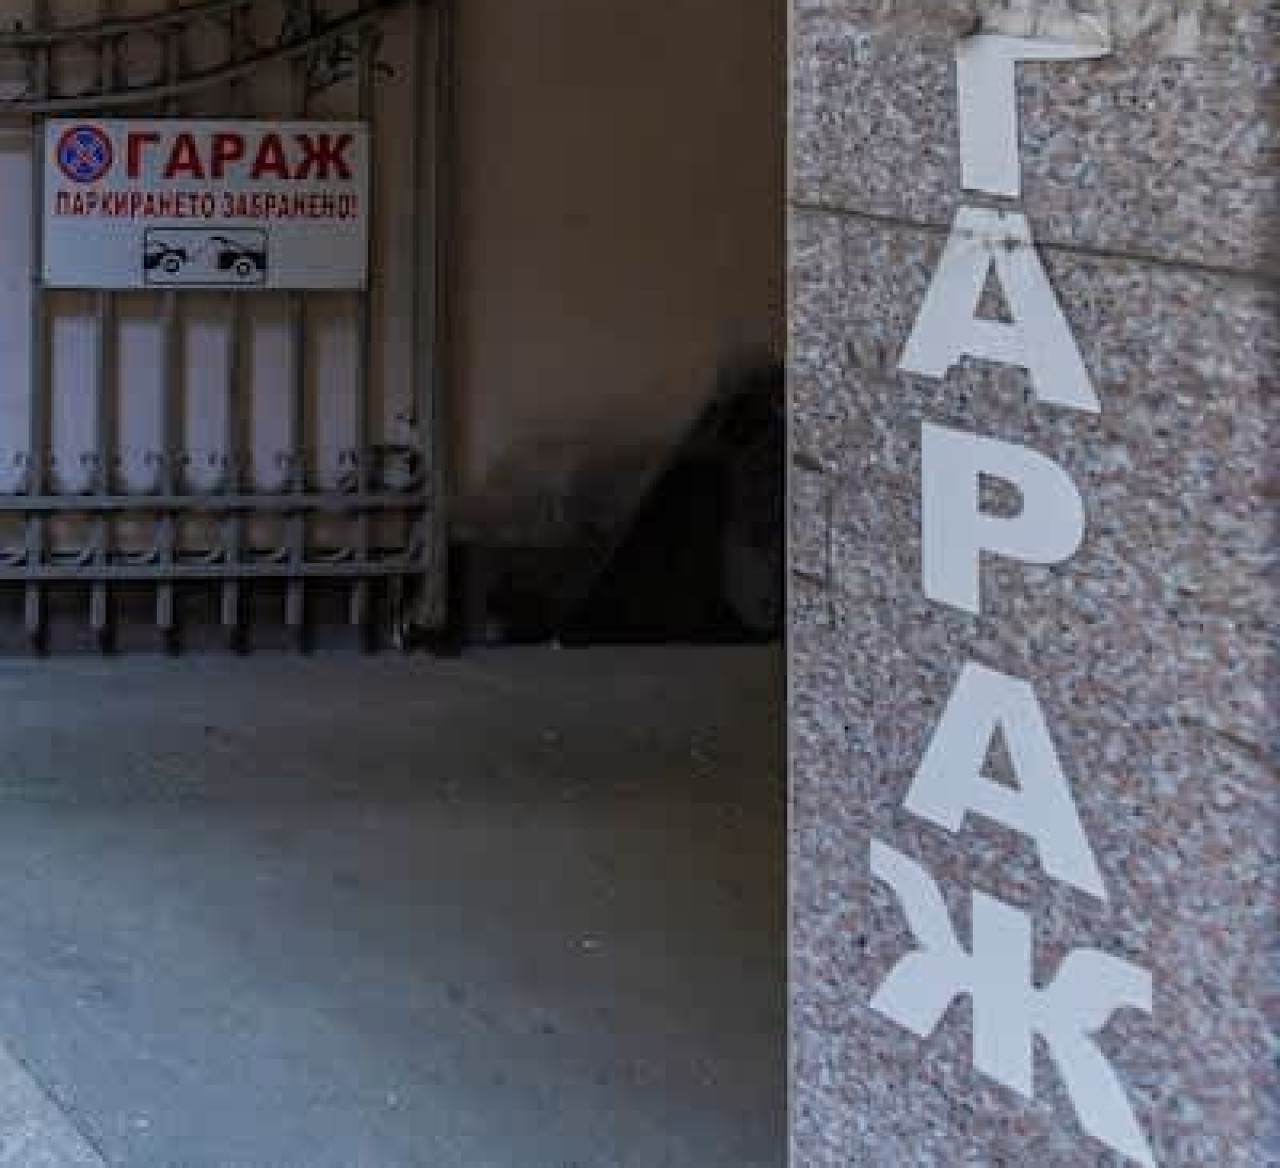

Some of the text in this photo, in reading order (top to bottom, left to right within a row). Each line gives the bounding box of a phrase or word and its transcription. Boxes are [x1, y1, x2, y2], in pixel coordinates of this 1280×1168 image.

[126, 131, 355, 180] ГАРАЖ
[53, 189, 216, 220] ПАРКИРАНЕТО
[870, 17, 1156, 1168] ГАРАЖ
